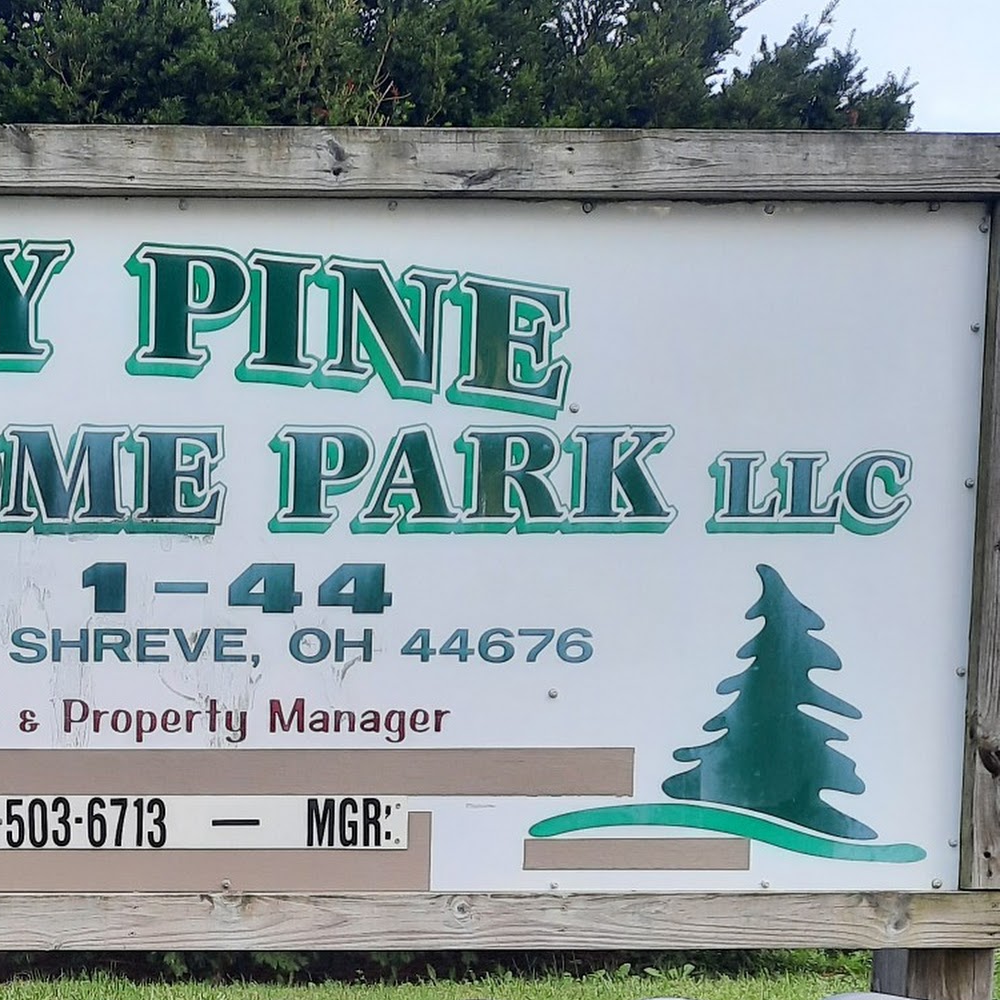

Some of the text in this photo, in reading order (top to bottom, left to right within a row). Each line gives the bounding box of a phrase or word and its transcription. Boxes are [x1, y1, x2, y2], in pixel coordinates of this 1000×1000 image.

[124, 242, 571, 419] PINE
[267, 423, 678, 534] PARK
[705, 449, 912, 535] LLC
[8, 627, 260, 668] SHREVE,
[289, 627, 374, 663] OH
[401, 628, 594, 664] 44676
[19, 710, 39, 733] &
[63, 699, 247, 743] Property
[269, 698, 451, 743] Manager
[306, 798, 392, 847] MGR:
